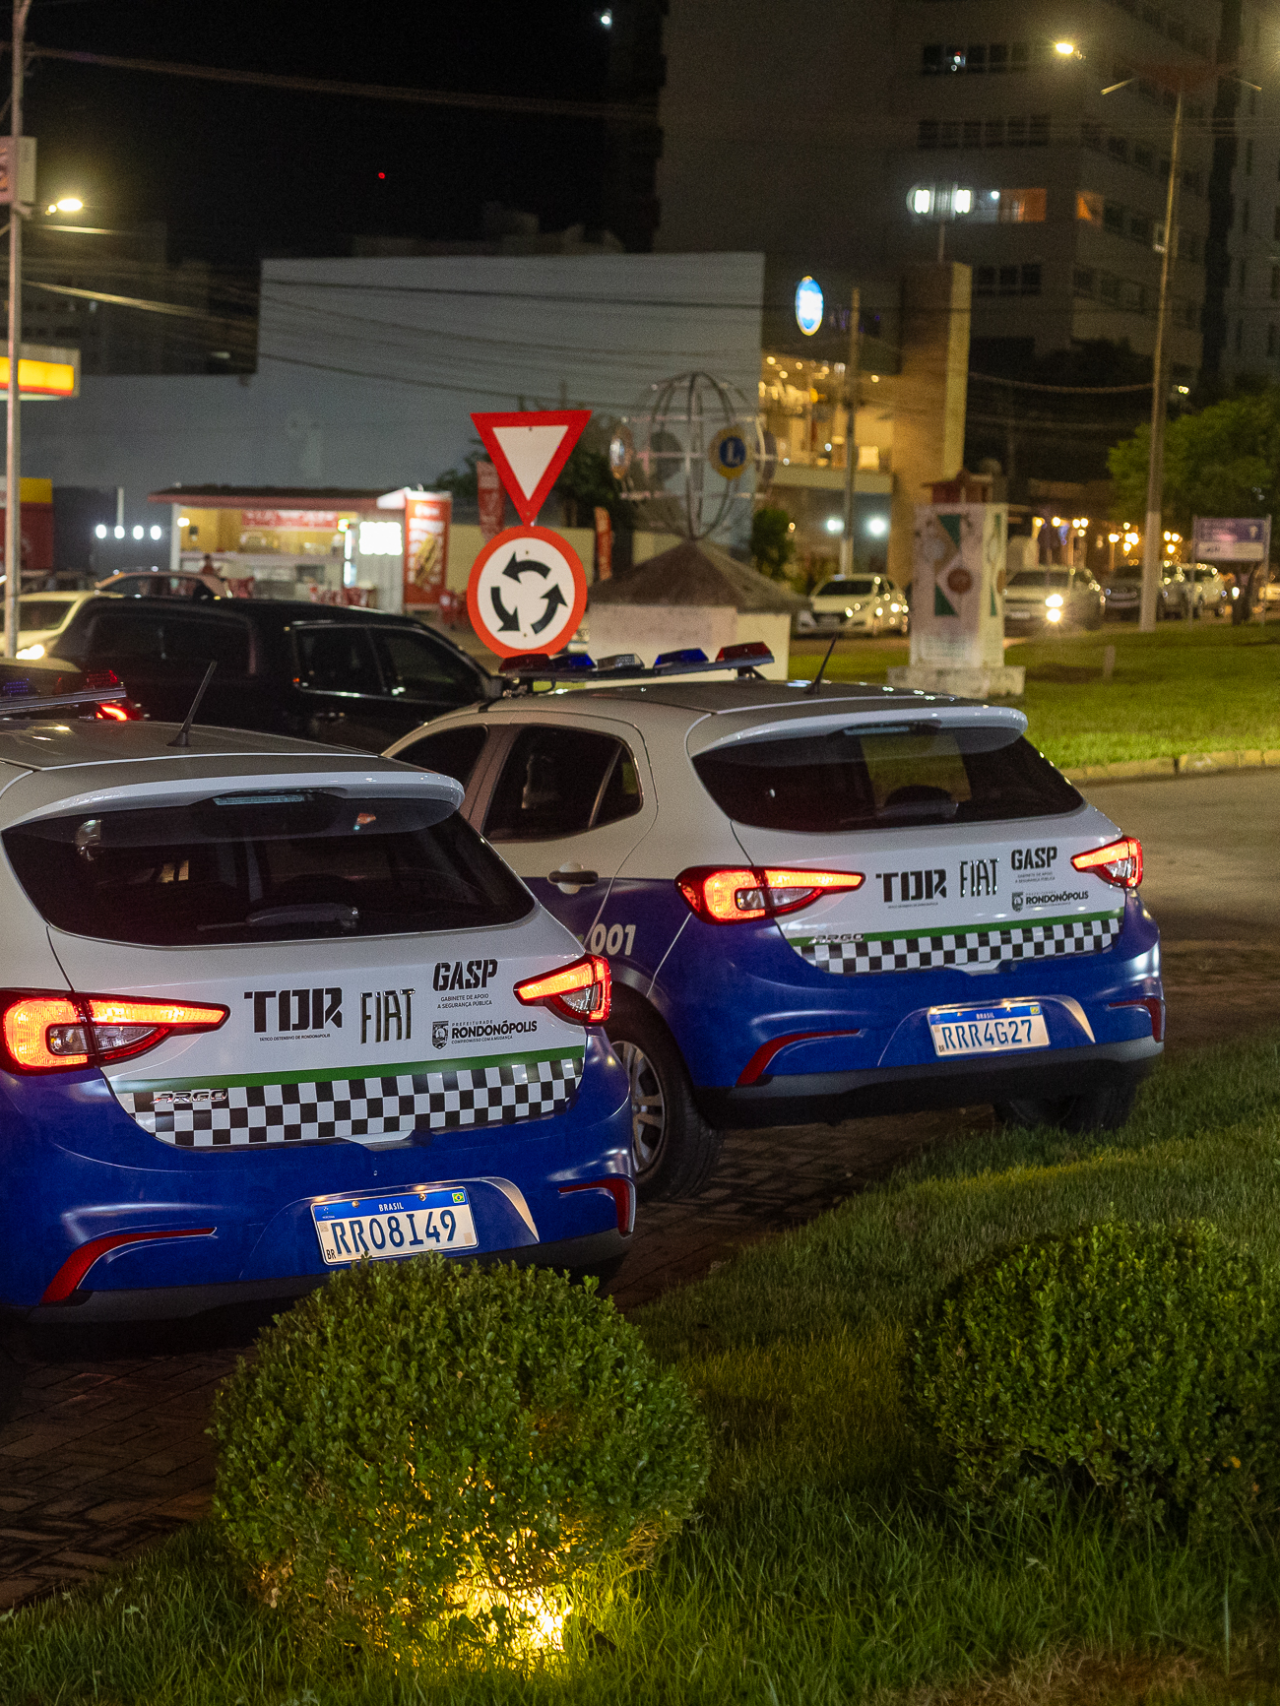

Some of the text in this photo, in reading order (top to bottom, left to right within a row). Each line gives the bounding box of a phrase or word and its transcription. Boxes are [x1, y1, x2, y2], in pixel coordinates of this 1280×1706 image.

[1011, 846, 1057, 871] GASP
[875, 868, 947, 903] TOR
[959, 858, 1000, 898] FIAT
[1026, 890, 1089, 905] RONDONÓPOLIS
[590, 923, 636, 956] 001
[808, 933, 864, 944] ARGO
[432, 959, 498, 992] GASP
[243, 987, 343, 1033] TOR
[360, 987, 416, 1044] FIAT
[451, 1020, 538, 1039] RONDONÓPOLIS
[941, 1018, 1032, 1049] RRR4G27
[150, 1089, 228, 1104] ARGO
[378, 1202, 404, 1212] BRASIL
[326, 1249, 336, 1260] BR
